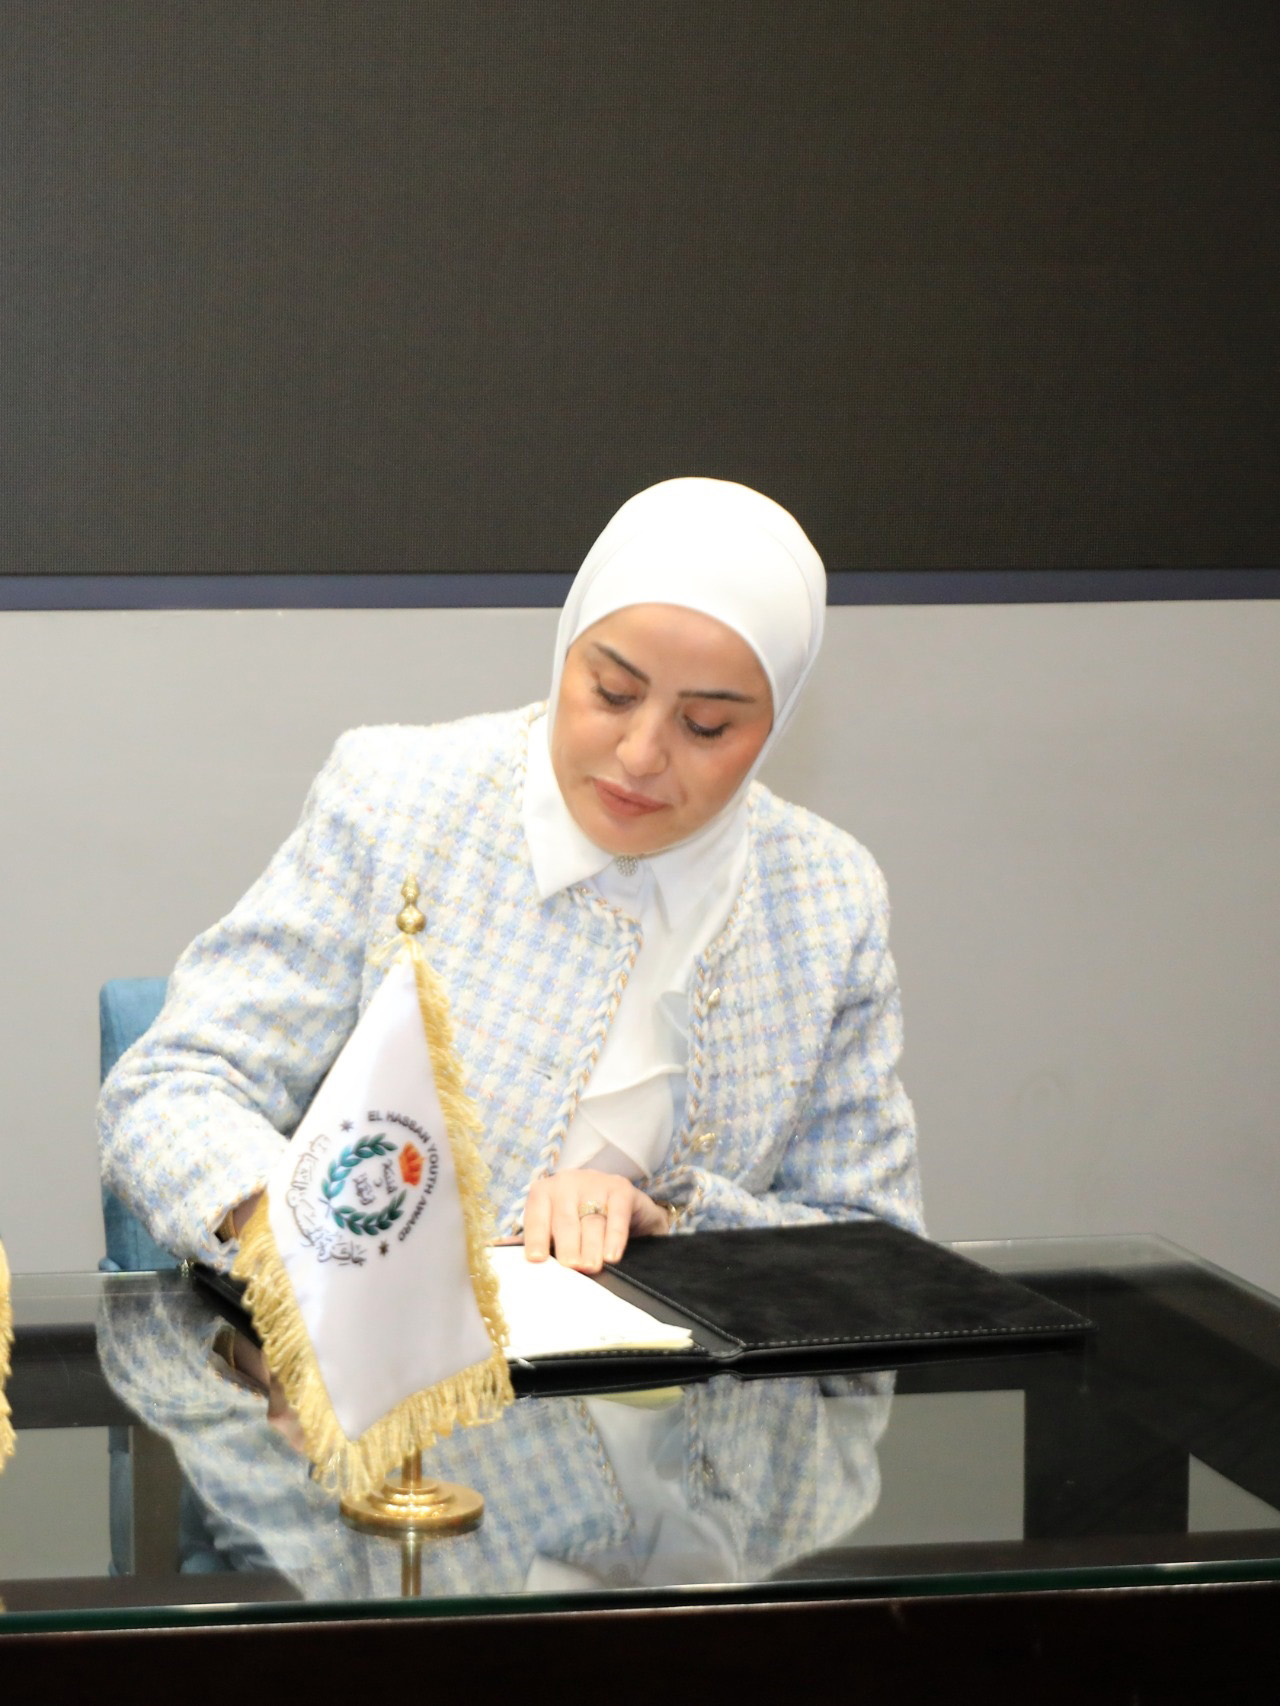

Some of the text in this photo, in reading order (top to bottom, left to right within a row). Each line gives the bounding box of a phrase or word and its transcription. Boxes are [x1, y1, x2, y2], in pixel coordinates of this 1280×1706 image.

[367, 1110, 382, 1122] EL
[386, 1110, 431, 1144] HASSAN
[424, 1143, 439, 1195] YOUTH
[397, 1195, 427, 1242] AWARD
